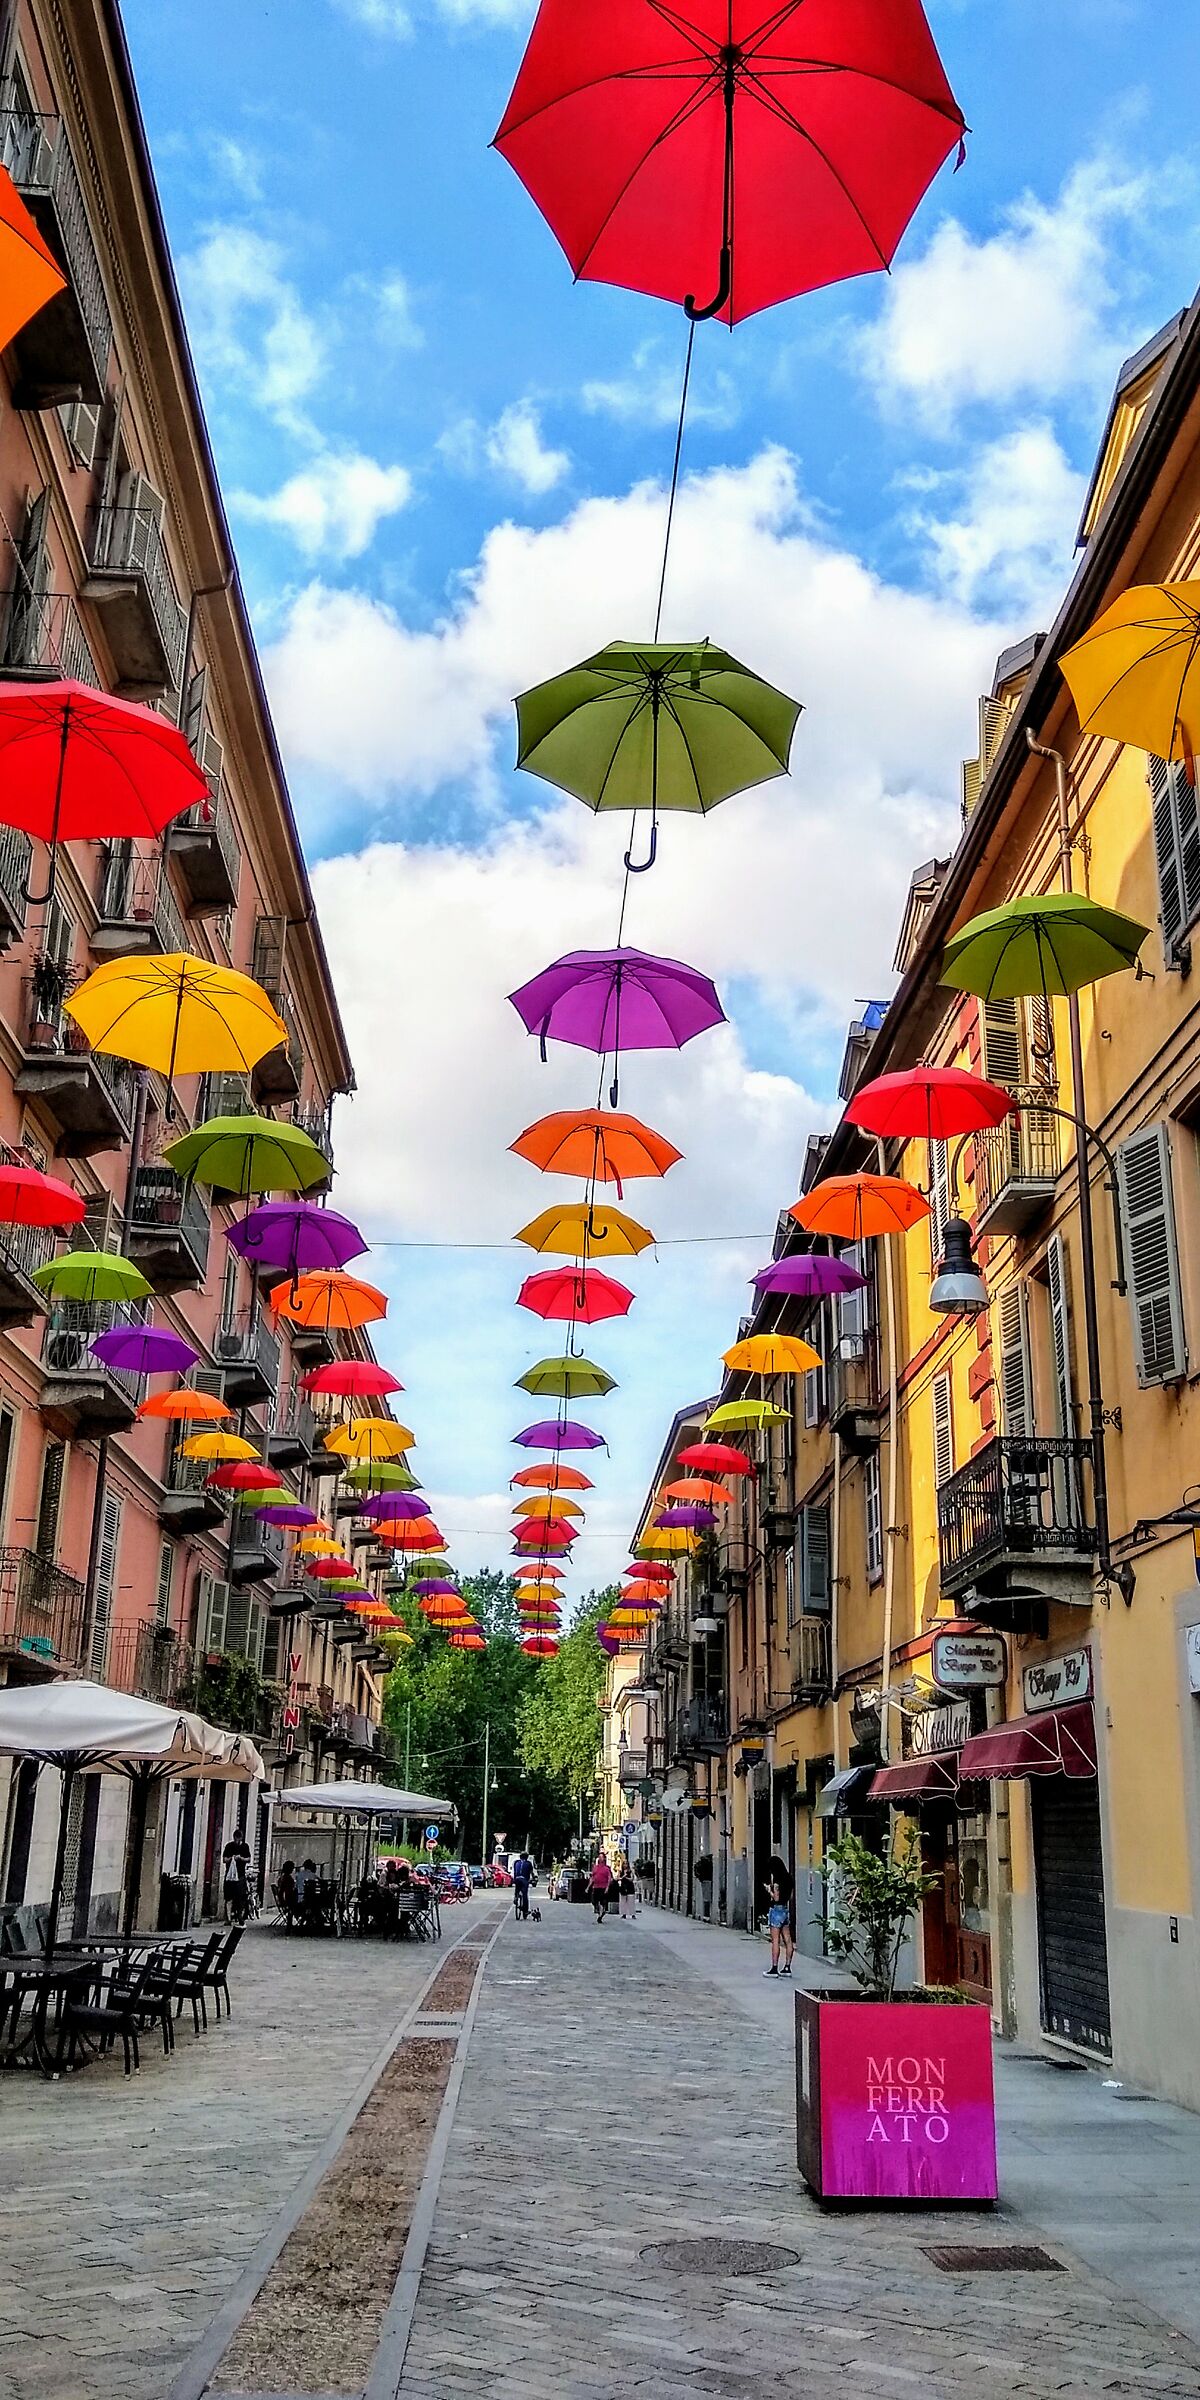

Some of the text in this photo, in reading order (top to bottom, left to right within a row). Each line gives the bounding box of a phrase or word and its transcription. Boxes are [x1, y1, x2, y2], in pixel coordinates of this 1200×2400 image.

[283, 1653, 301, 1755] VINI
[866, 2056, 946, 2085] MON
[866, 2085, 950, 2114] FERR
[866, 2114, 949, 2143] ATO
